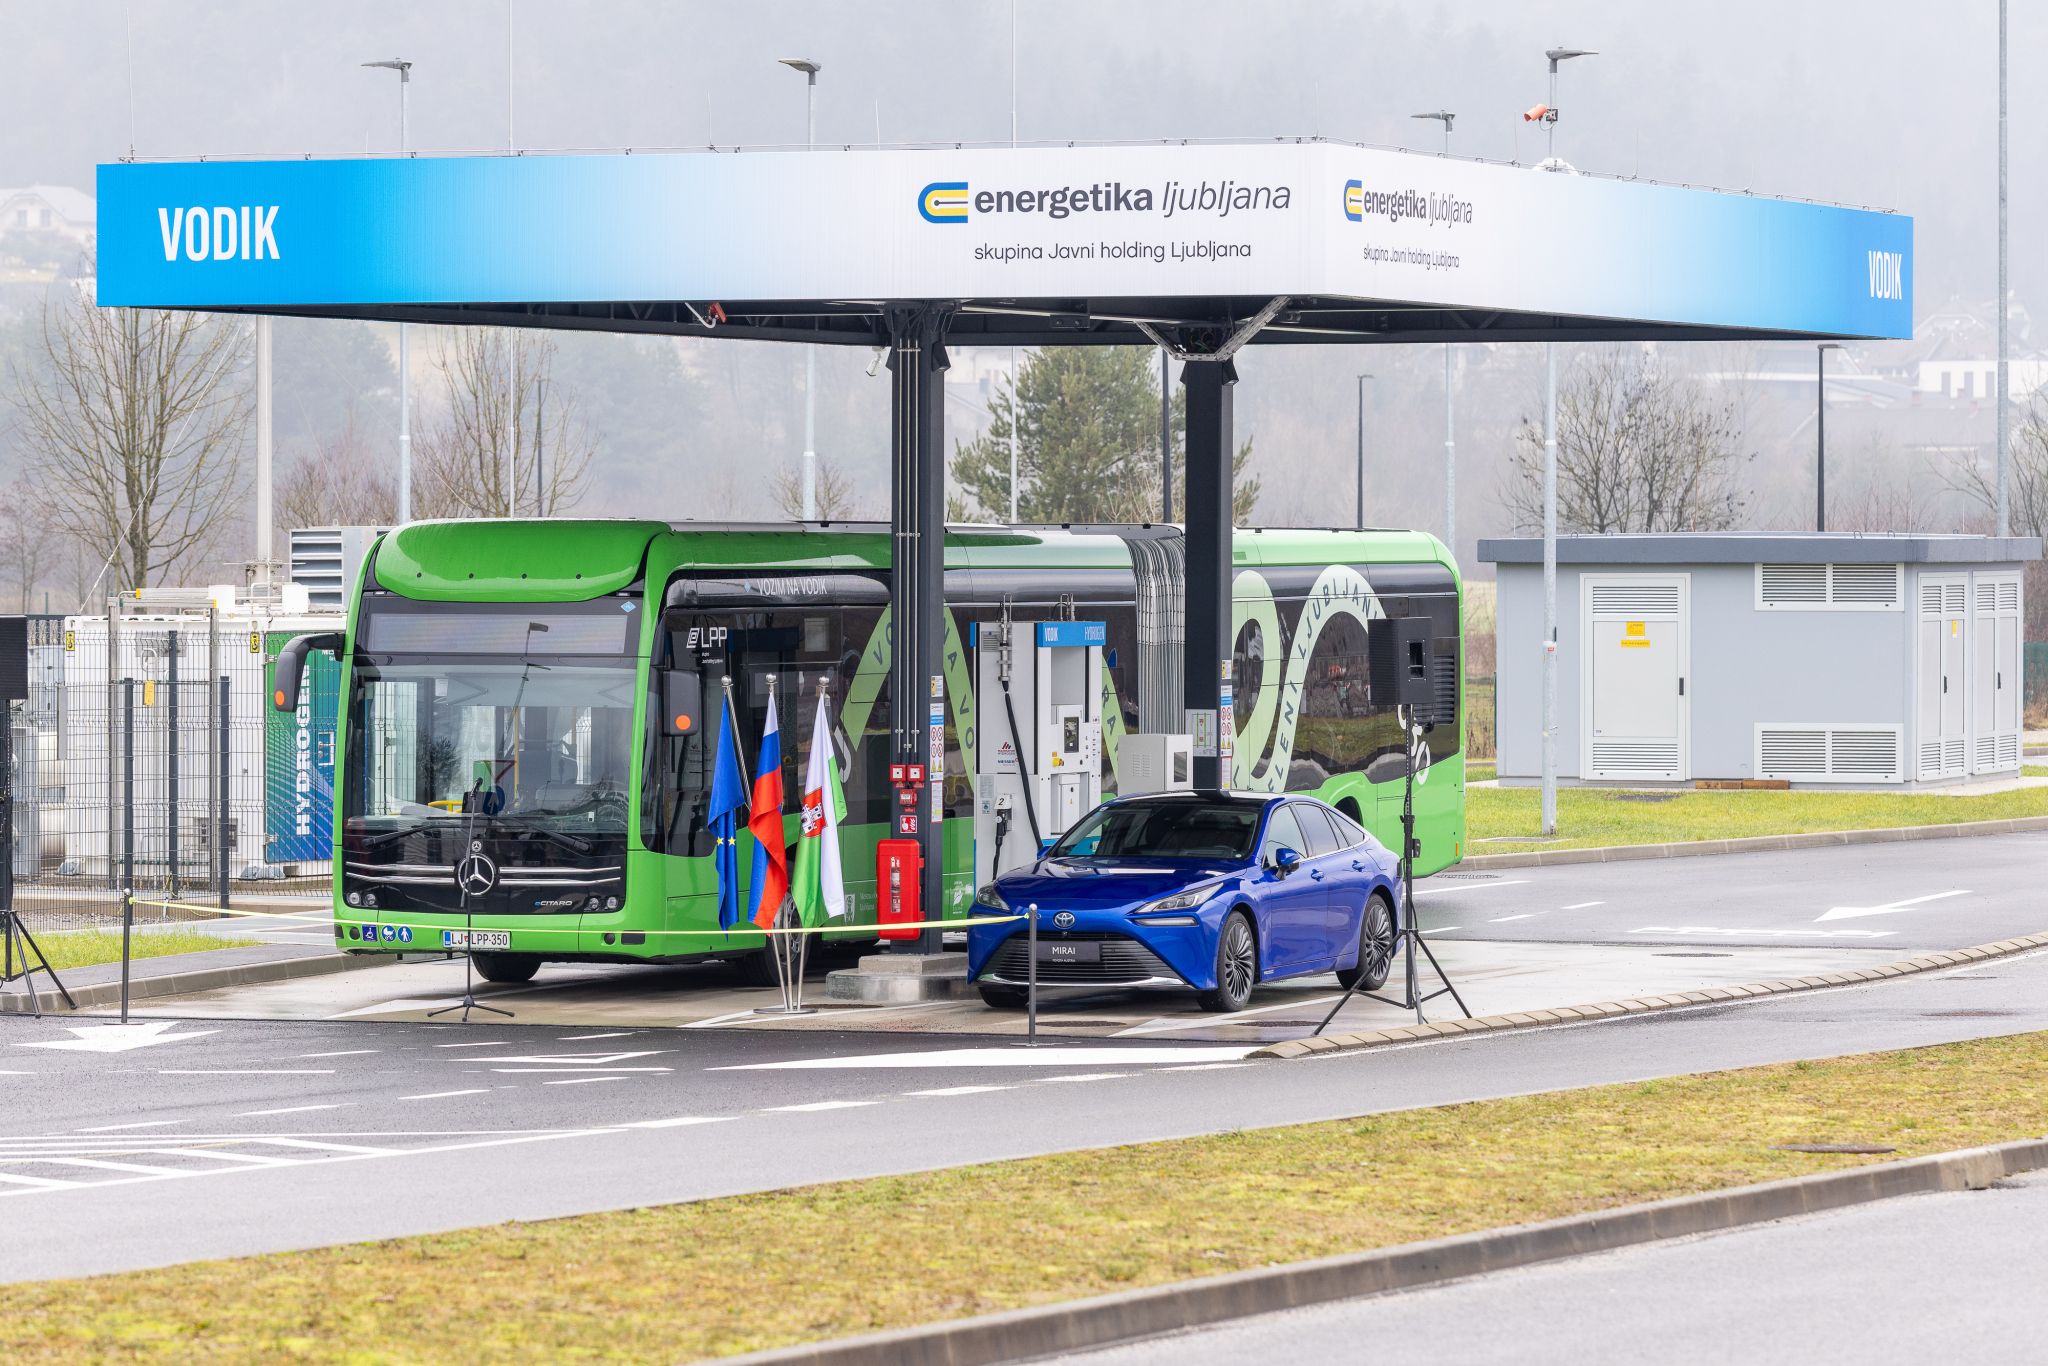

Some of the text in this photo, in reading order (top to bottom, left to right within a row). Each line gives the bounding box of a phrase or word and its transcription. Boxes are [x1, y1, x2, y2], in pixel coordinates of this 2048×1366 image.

[974, 180, 1291, 220] energetika ljubljana
[1363, 189, 1473, 229] energetika ljubljana
[158, 206, 280, 261] VODIK
[974, 240, 1251, 265] skupina Javni holding Ljubljana
[1363, 244, 1460, 271] skupina Javni holding Ljubljana
[1868, 251, 1902, 300] VODIK
[757, 578, 827, 596] VOZIM NA VODIK
[700, 626, 728, 648] LPP
[1044, 627, 1059, 642] VODIK
[998, 797, 1005, 806] 2
[452, 933, 508, 946] LJ LPP-350
[1052, 946, 1076, 955] MIRAI
